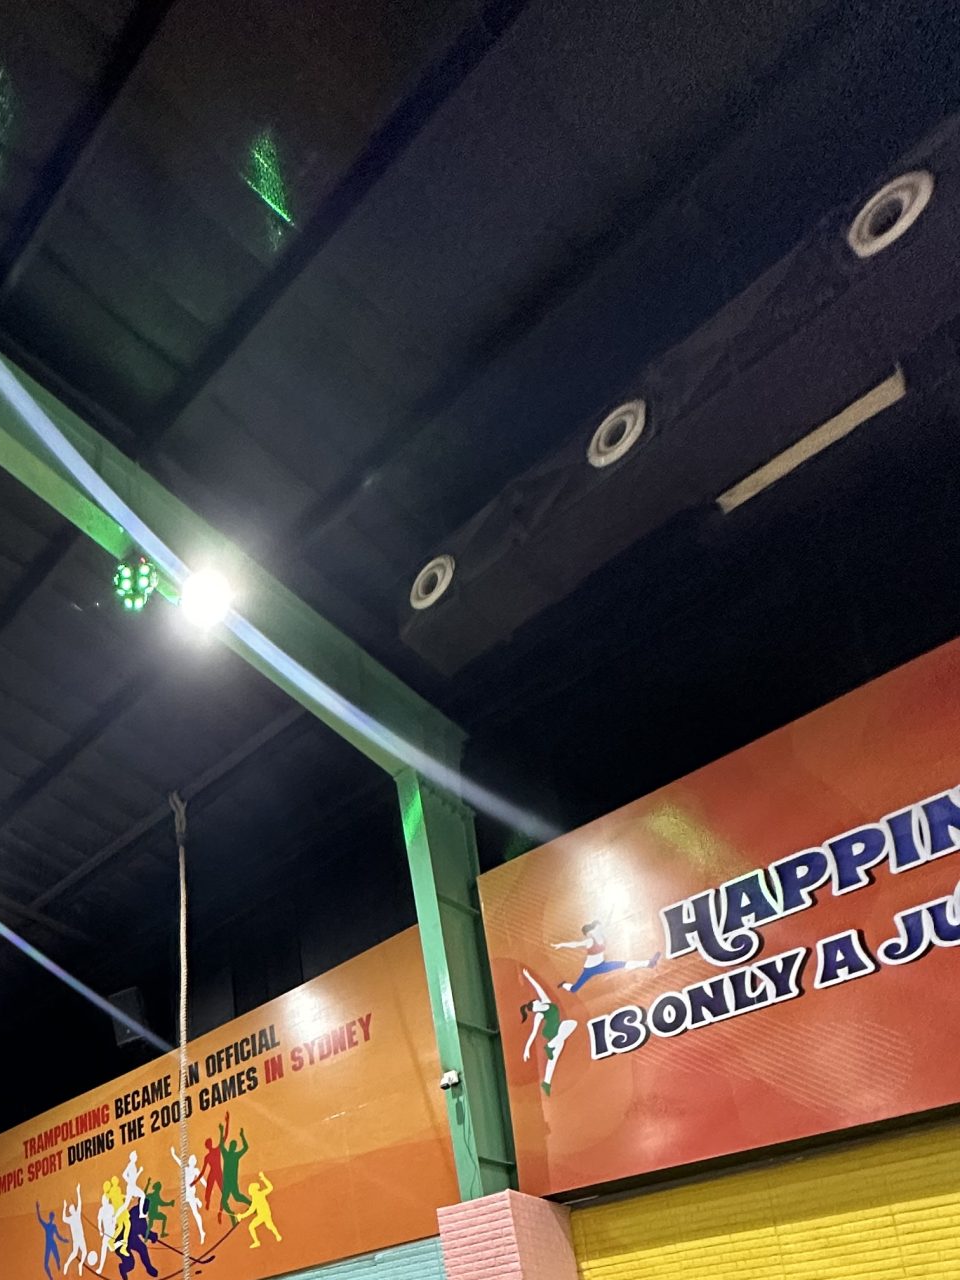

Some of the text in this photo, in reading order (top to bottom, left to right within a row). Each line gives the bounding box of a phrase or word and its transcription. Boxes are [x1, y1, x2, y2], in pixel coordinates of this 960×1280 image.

[587, 1005, 646, 1060] IS
[647, 947, 807, 1037] ONLY
[813, 929, 876, 989] A
[22, 1104, 110, 1159] TRAMPOLINING
[114, 1074, 172, 1119] BECAME
[205, 1024, 280, 1078] OFFICIAL
[27, 1151, 64, 1182] SPORT
[67, 1129, 115, 1167] DURING
[119, 1115, 145, 1145] THE
[150, 1095, 193, 1133] 2000
[198, 1066, 259, 1112] GAMES
[264, 1053, 284, 1085] IN
[291, 1013, 372, 1072] SYDNEY
